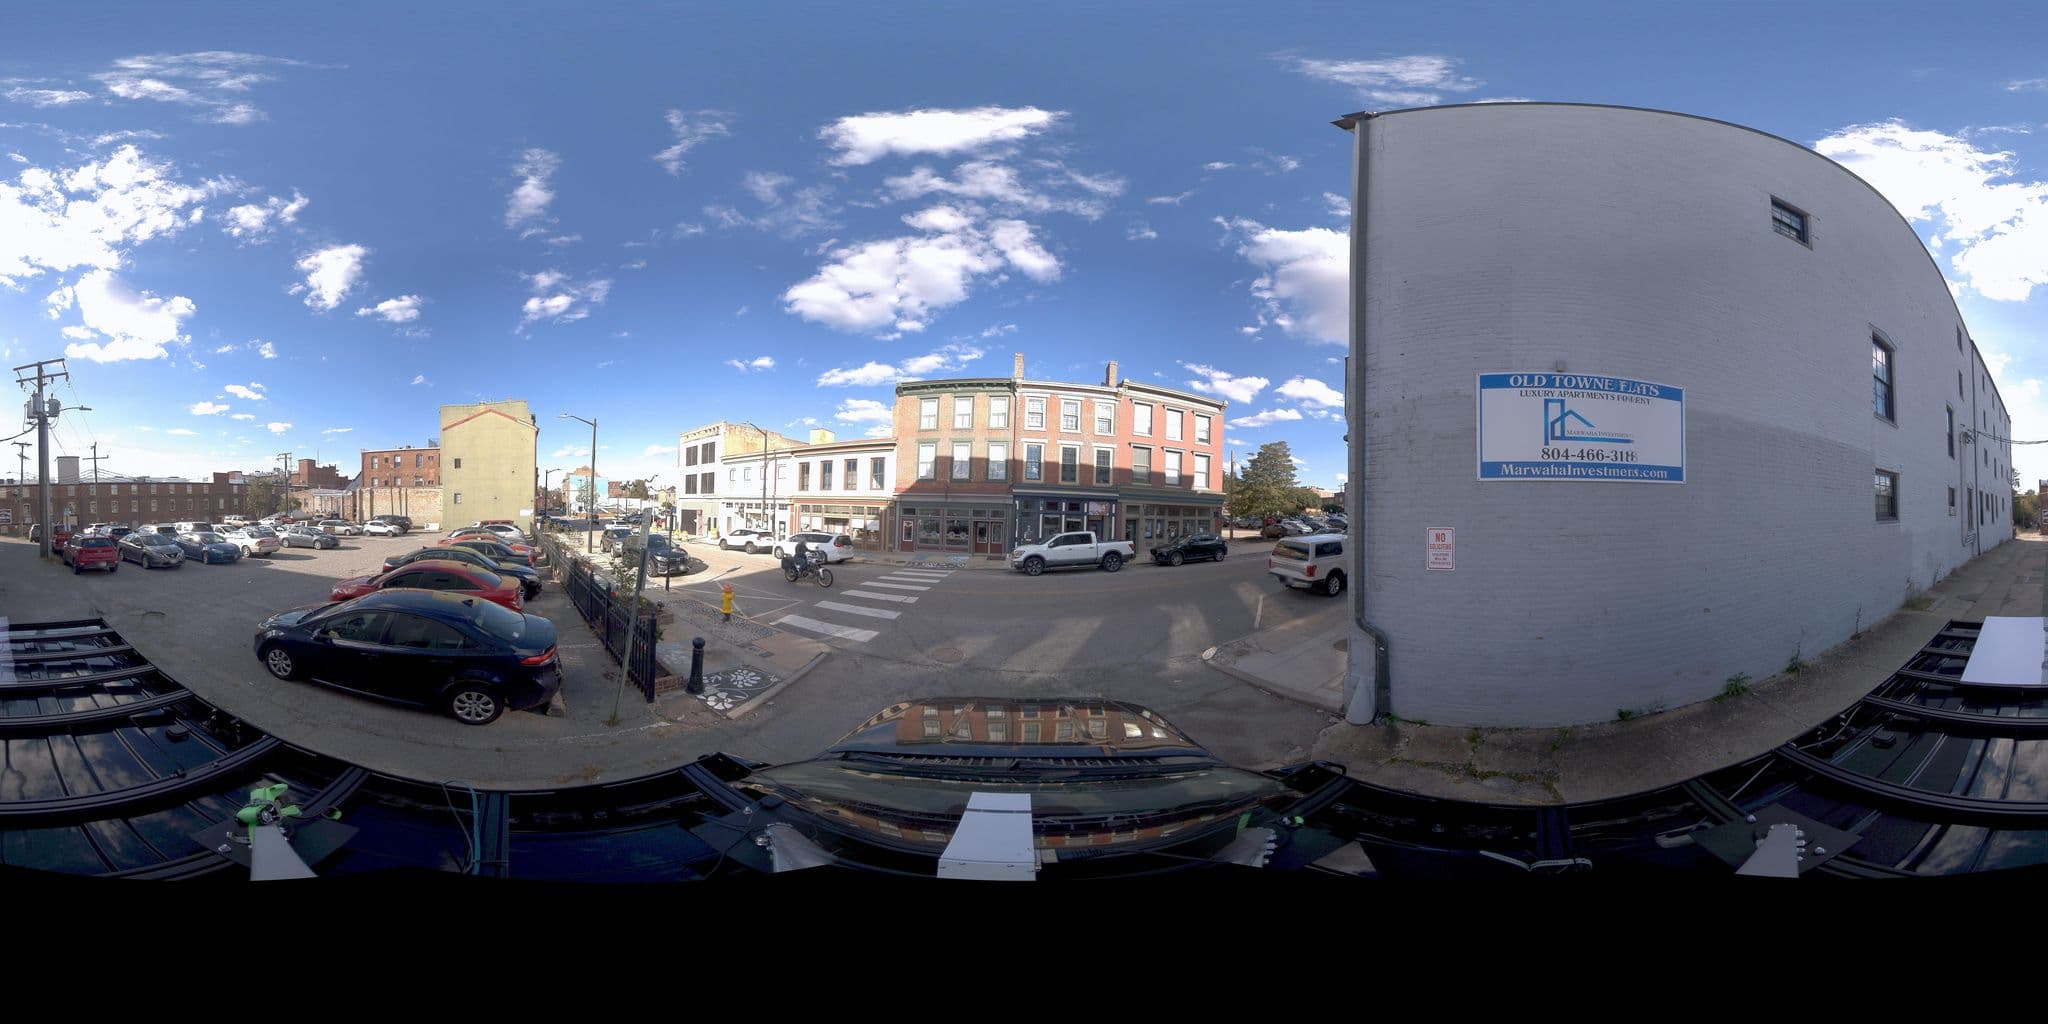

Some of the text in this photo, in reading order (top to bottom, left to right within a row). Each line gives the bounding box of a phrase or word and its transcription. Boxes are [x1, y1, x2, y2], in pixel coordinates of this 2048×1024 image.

[1509, 374, 1547, 387] OLD
[1552, 375, 1615, 391] TOWNE
[1520, 389, 1556, 398] LUXURY
[1557, 390, 1616, 401] APARTMENTS
[1435, 532, 1446, 542] NO
